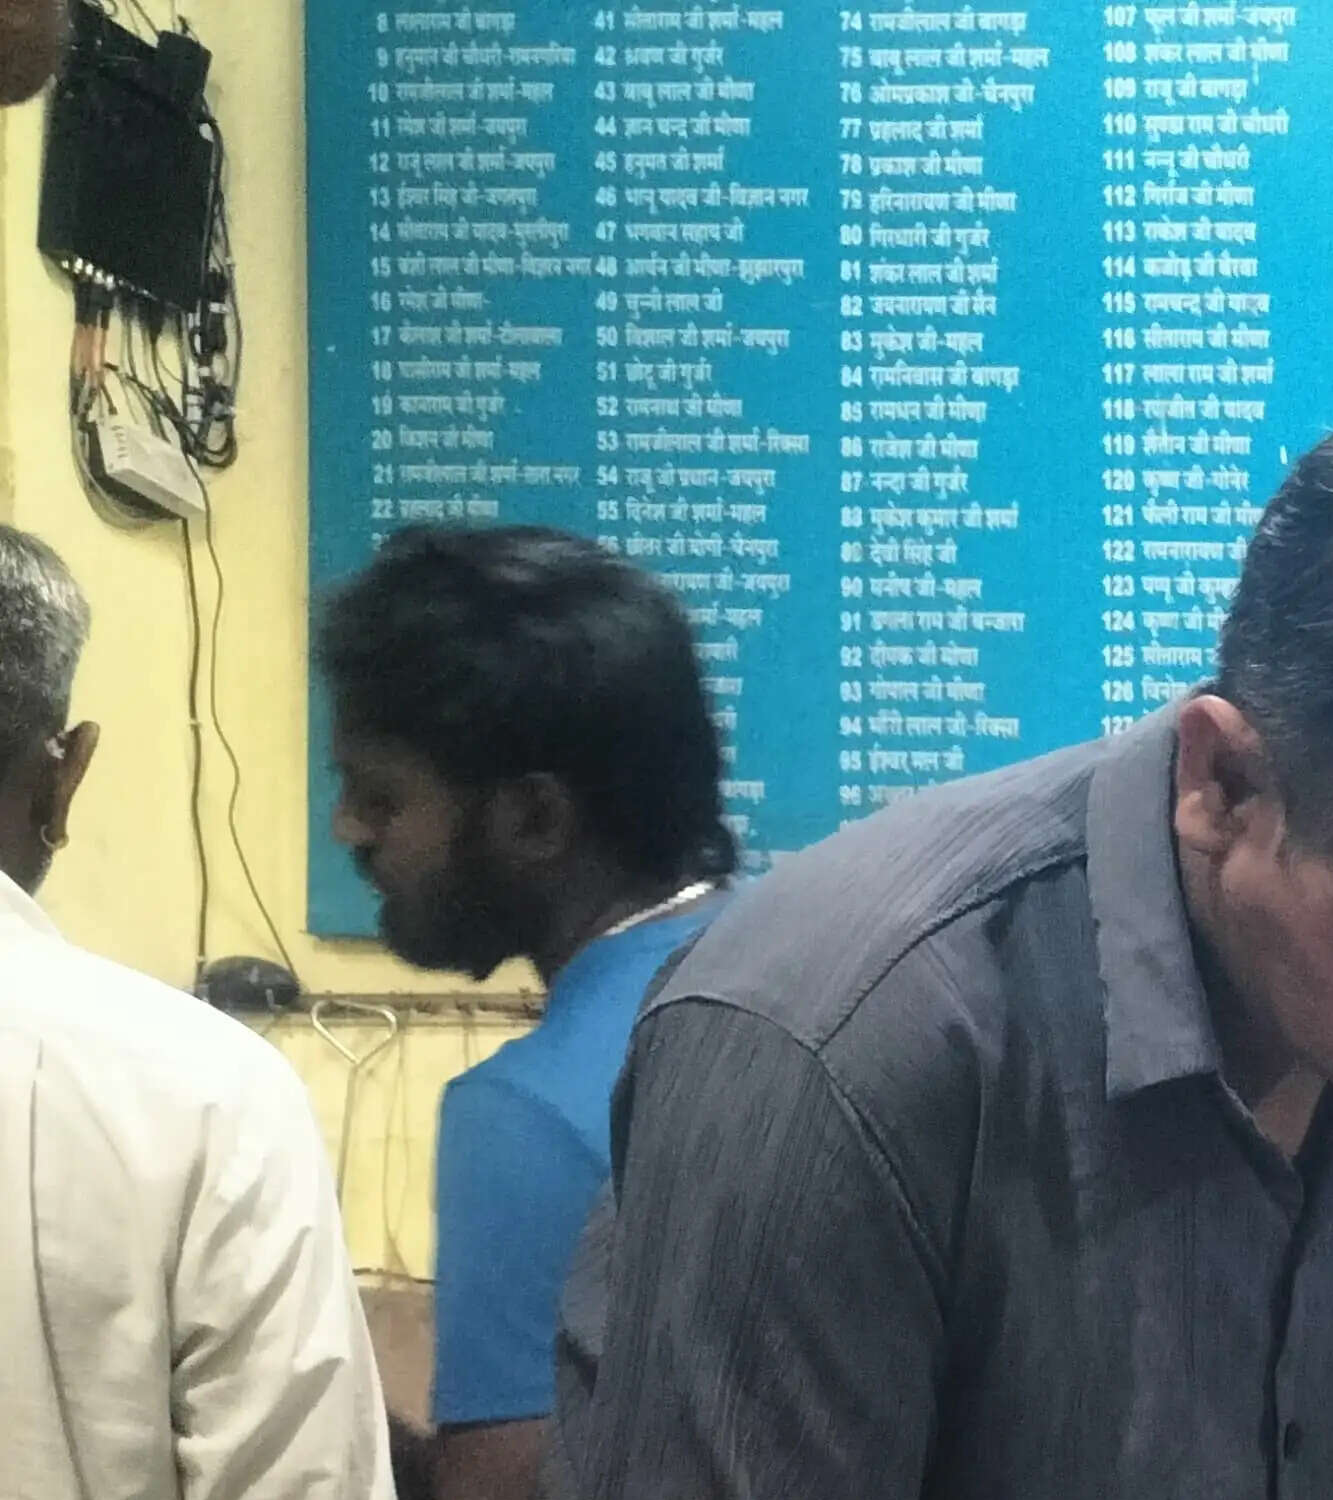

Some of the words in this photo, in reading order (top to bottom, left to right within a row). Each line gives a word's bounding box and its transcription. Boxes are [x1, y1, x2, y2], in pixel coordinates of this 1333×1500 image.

[595, 46, 616, 65] 42
[667, 40, 688, 64] जी
[595, 117, 616, 136] 44
[690, 111, 711, 135] जी
[840, 118, 862, 137] 77
[925, 115, 946, 139] जी
[596, 291, 617, 311] 49
[702, 288, 723, 311] जी
[841, 365, 862, 387] 84
[947, 360, 968, 385] जी
